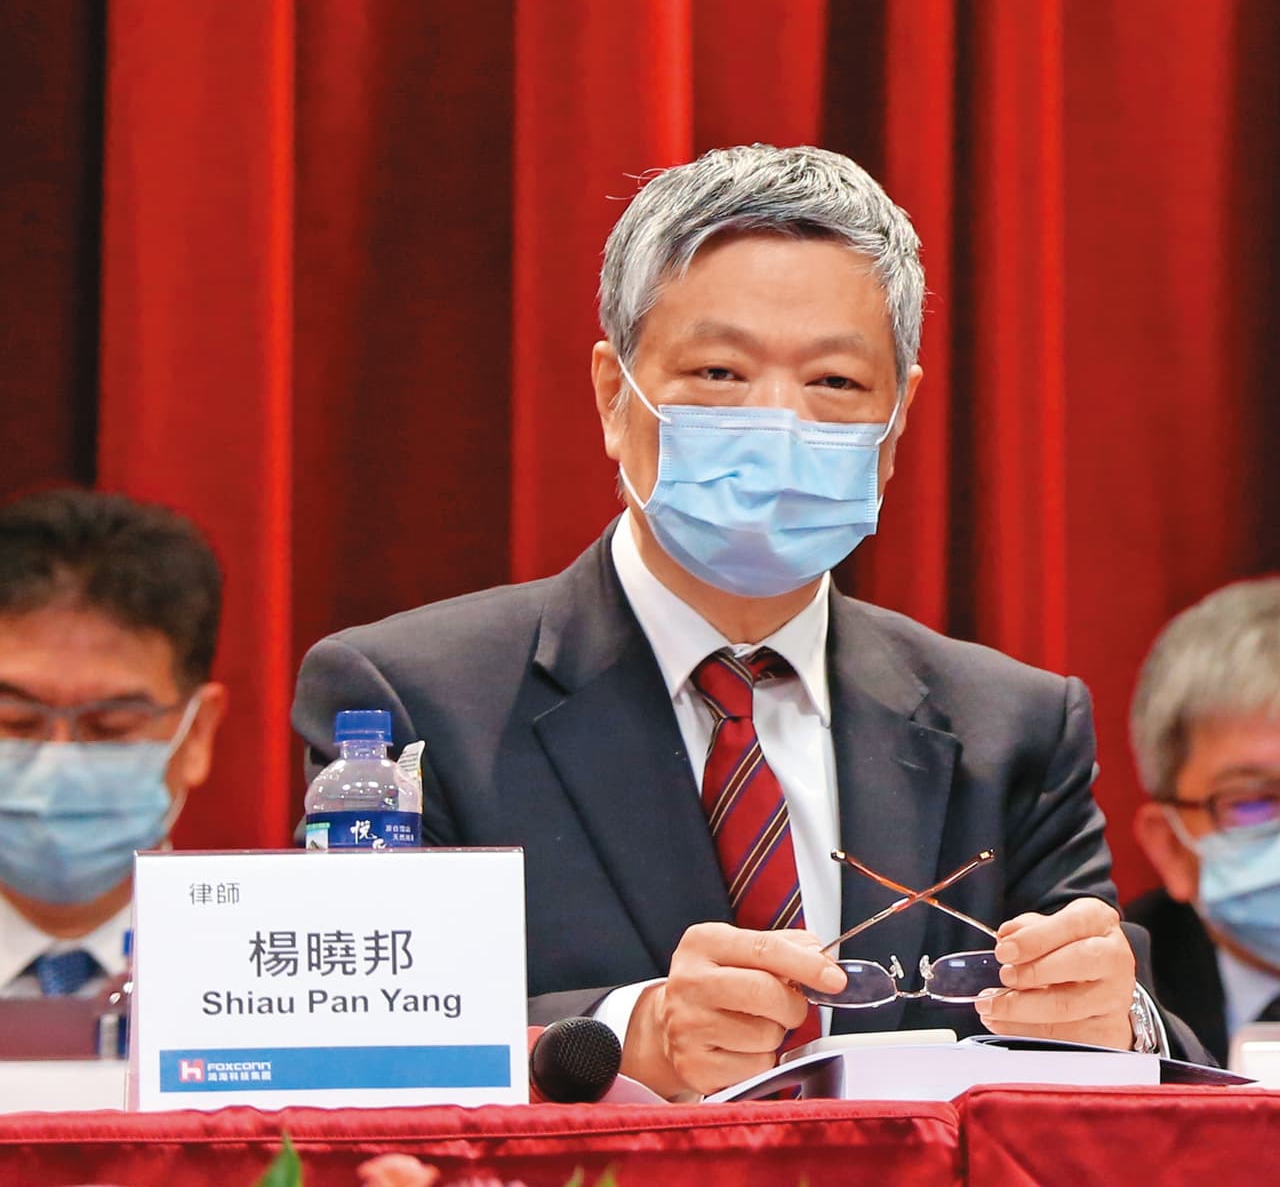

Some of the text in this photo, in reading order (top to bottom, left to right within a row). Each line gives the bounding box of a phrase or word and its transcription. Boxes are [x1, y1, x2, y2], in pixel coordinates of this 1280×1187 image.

[189, 883, 240, 905] 律師
[249, 929, 414, 977] 楊曉邦
[202, 987, 462, 1019] Shiau Pan Yang
[207, 1061, 272, 1072] FOXCONN
